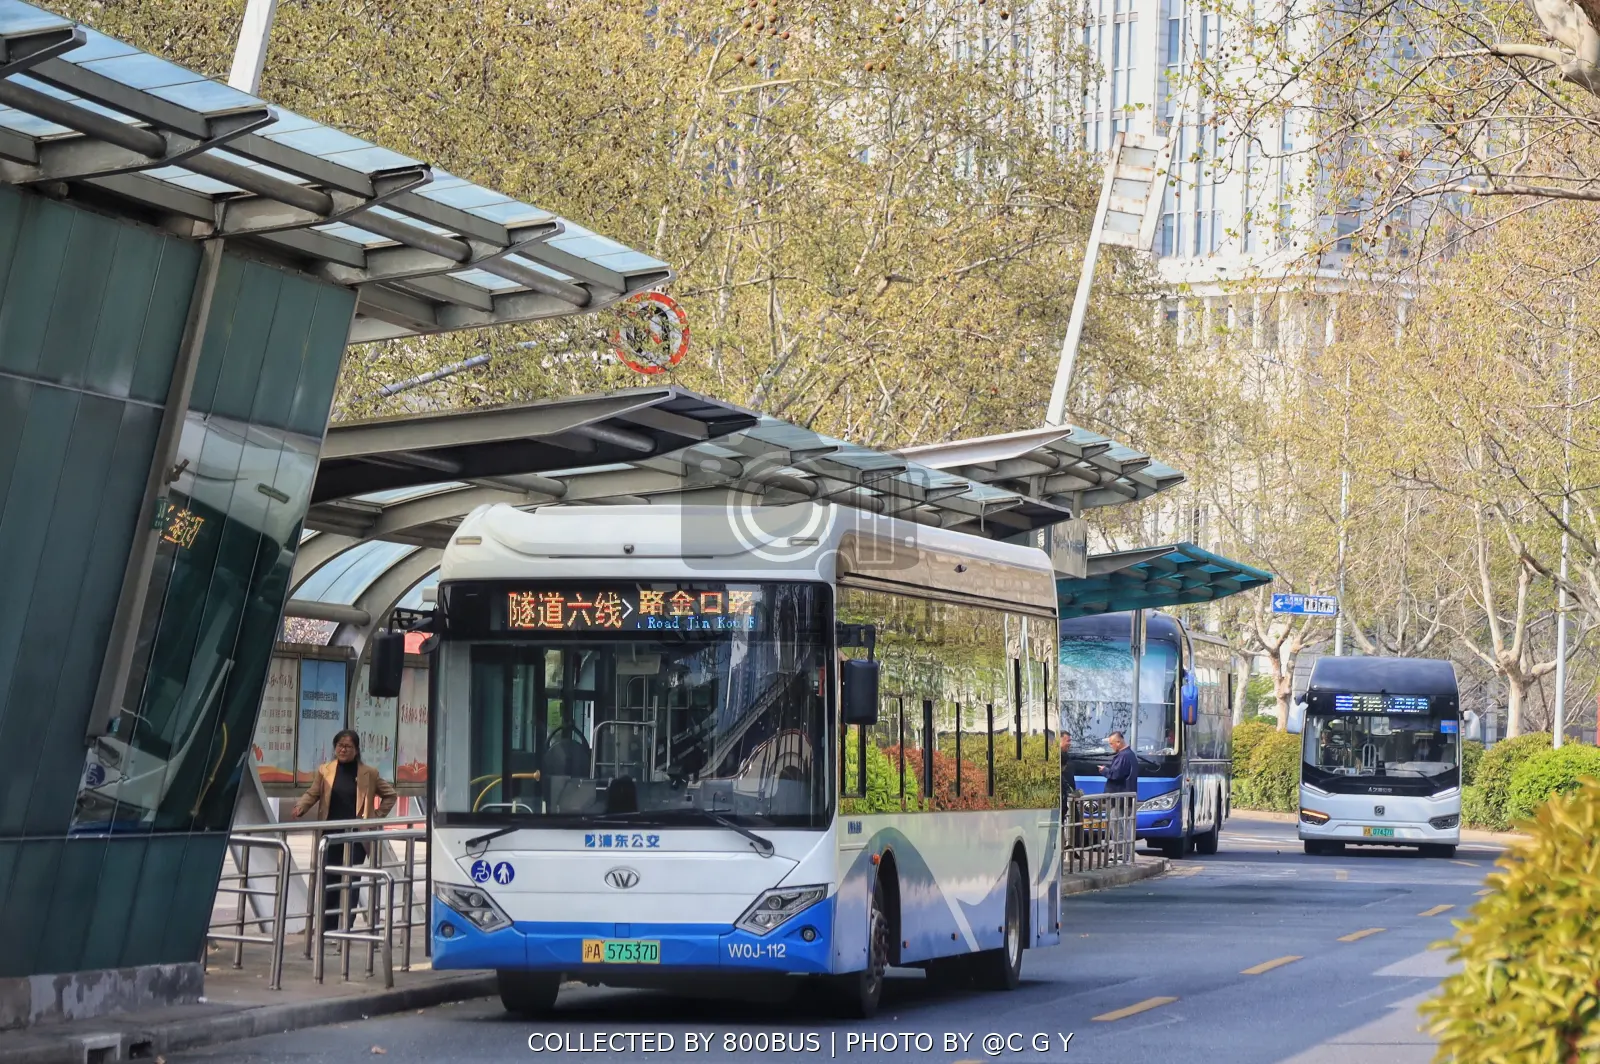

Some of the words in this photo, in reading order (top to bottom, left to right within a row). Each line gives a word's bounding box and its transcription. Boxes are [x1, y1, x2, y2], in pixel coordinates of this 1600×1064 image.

[508, 590, 622, 629] 隧道六线
[638, 590, 753, 615] 路金口路
[647, 615, 680, 629] Road
[686, 615, 711, 631] Jin
[598, 833, 661, 848] 浦东公交
[607, 944, 658, 961] 57537D
